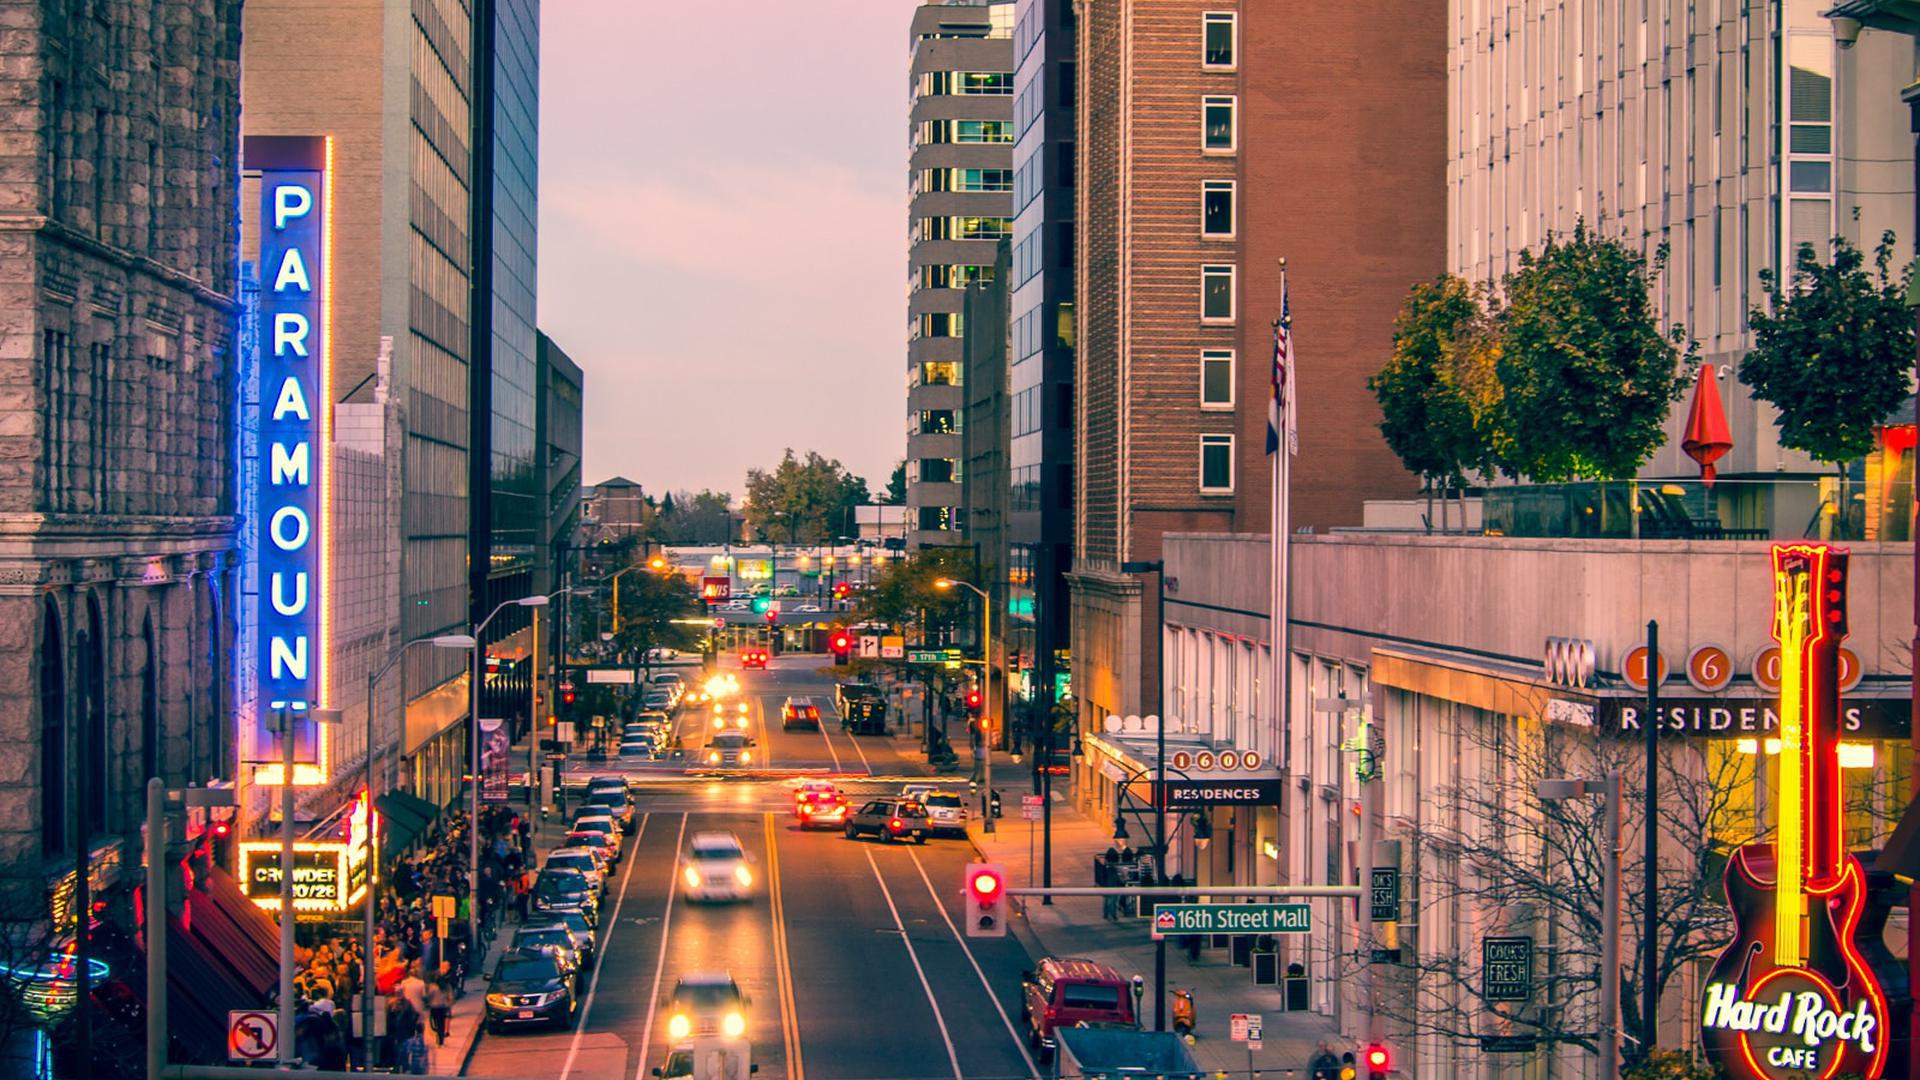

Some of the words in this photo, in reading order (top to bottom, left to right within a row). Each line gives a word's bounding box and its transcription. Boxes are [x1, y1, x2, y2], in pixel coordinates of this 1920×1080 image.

[271, 186, 313, 709] PARAMOUN
[704, 584, 728, 597] AVIS
[1621, 707, 1861, 731] RSIDENS
[1177, 754, 1257, 768] 1600
[1173, 788, 1260, 800] RESIDENCES
[1373, 874, 1393, 887] OK'S
[1373, 890, 1393, 904] ESH
[1177, 909, 1213, 928] 16th
[1217, 909, 1269, 928] Street
[1273, 908, 1308, 928] Mall
[1489, 964, 1526, 981] FRESH
[1703, 983, 1793, 1033] Hard
[1793, 991, 1877, 1053] Rock
[1767, 1047, 1818, 1069] CAFE
